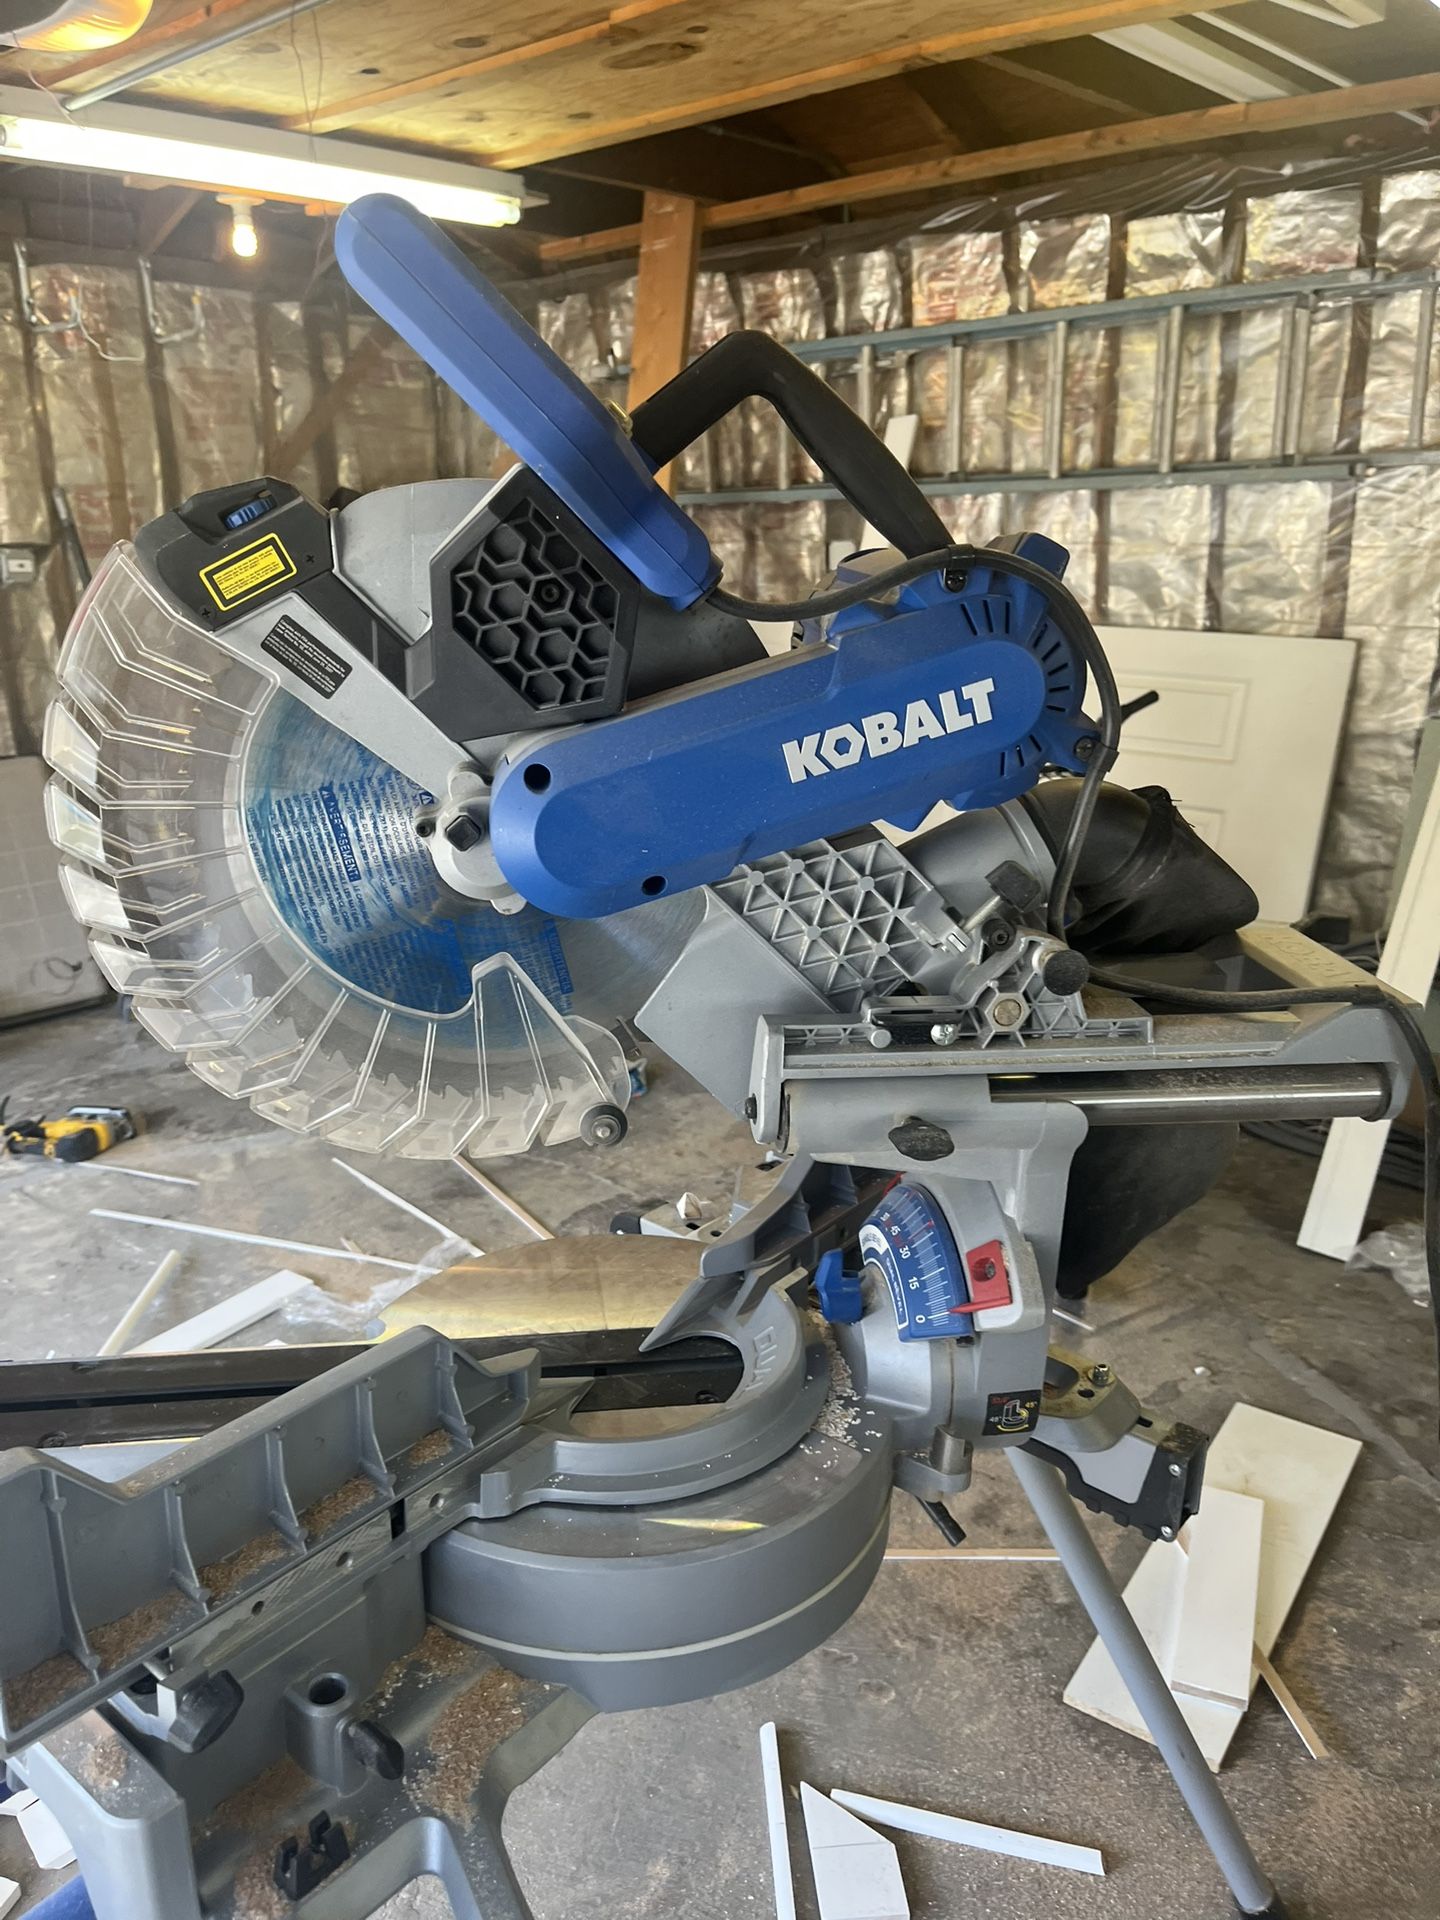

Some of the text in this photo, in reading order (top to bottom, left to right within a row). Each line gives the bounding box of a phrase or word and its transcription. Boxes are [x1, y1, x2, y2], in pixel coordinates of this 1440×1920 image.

[782, 677, 994, 784] KOBALT
[891, 1225, 901, 1236] 45
[899, 1245, 911, 1259] 30
[908, 1276, 920, 1290] 15
[915, 1315, 925, 1323] 0
